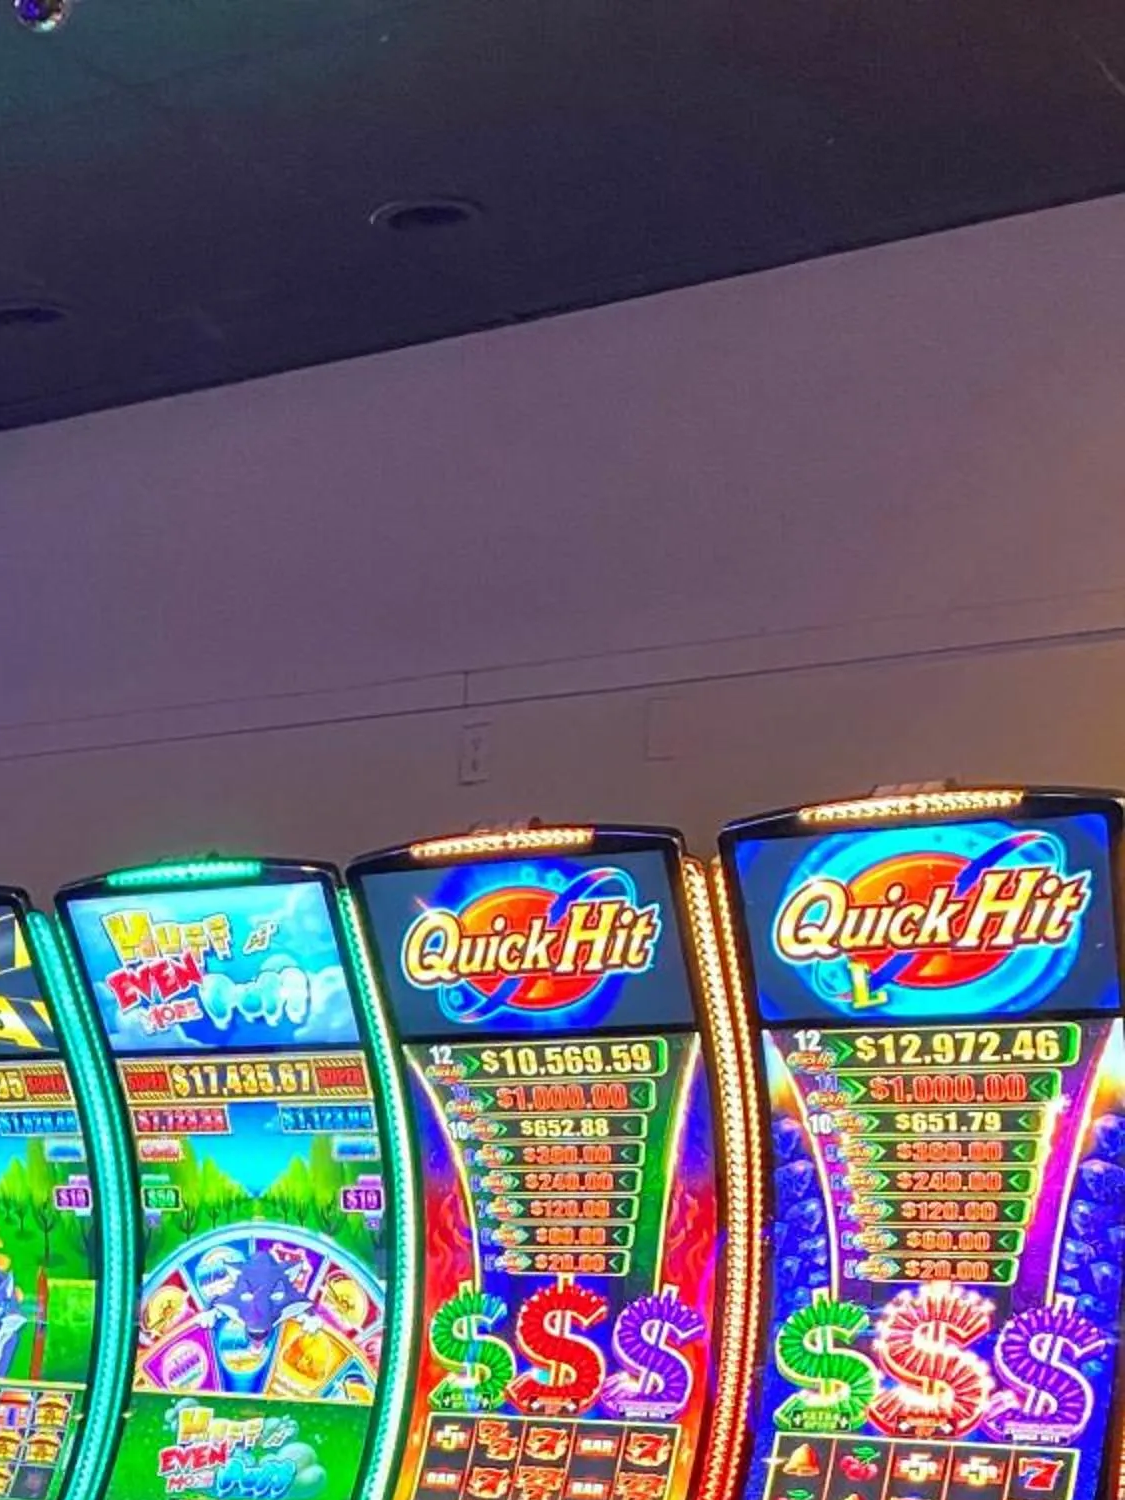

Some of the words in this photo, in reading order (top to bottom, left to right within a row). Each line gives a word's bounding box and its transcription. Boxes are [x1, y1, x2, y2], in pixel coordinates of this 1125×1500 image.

[775, 872, 959, 961] Quick
[956, 863, 1092, 950] Hit
[403, 907, 559, 986] Quick
[554, 898, 661, 974] Hit
[105, 952, 203, 1014] EVEN
[429, 1045, 454, 1065] 12
[794, 1030, 822, 1051] 12
[520, 1118, 610, 1138] $652.88
[895, 1112, 1002, 1132] $651.79
[158, 1440, 229, 1476] EVEN
[1019, 1458, 1064, 1491] 7
